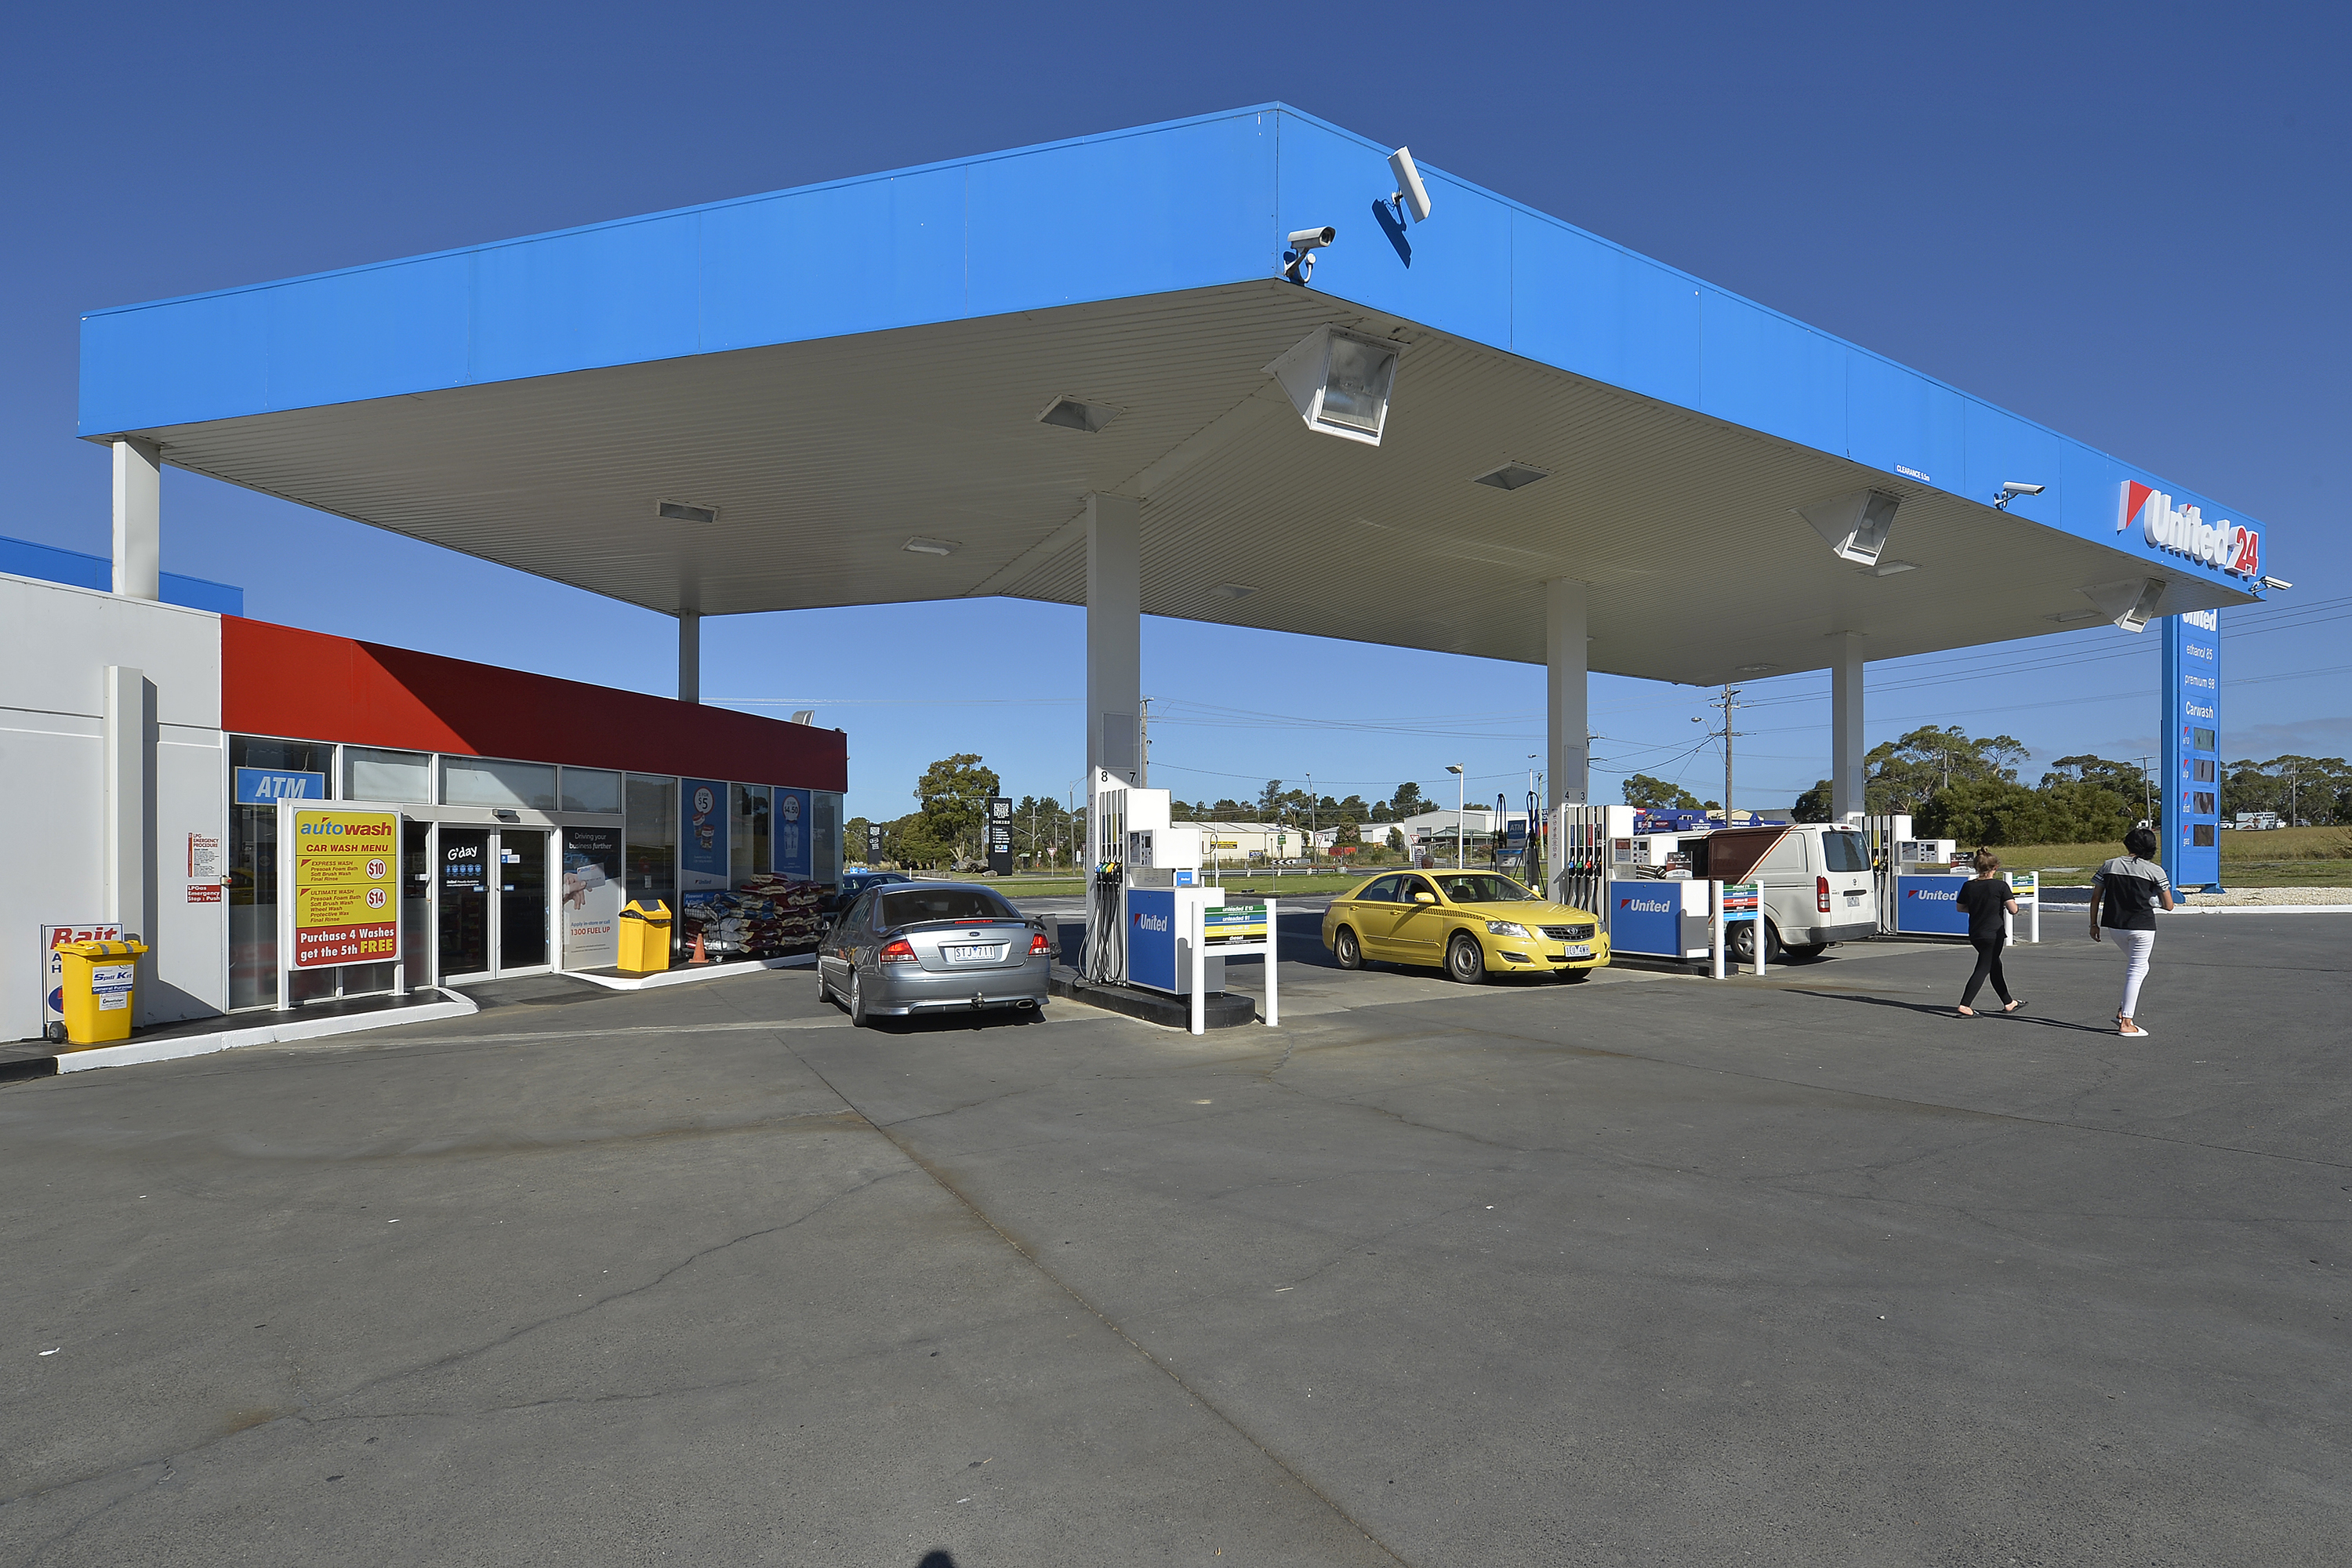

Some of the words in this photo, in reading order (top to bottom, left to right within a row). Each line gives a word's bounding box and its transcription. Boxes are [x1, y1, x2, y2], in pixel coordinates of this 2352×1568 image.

[1896, 464, 1921, 478] CLEARANCE
[2145, 490, 2230, 565] United
[2230, 525, 2259, 577] 24
[2187, 644, 2205, 659] ethanol
[2206, 648, 2213, 660] 85
[2184, 674, 2207, 688] premium
[2209, 678, 2216, 689] 98
[2186, 701, 2214, 719] Carwash
[1101, 771, 1108, 782] 8
[1129, 772, 1136, 782] 7
[255, 776, 307, 799] ATM
[1565, 791, 1570, 800] 4
[698, 797, 708, 809] $5
[1564, 804, 1570, 813] 6
[300, 818, 392, 836] autowash
[1509, 823, 1525, 832] ATM
[448, 846, 477, 861] G'day
[368, 862, 384, 876] $10
[368, 891, 384, 906] $14
[1918, 890, 1958, 901] United
[1631, 899, 1671, 913] United
[1141, 913, 1168, 932] United
[50, 927, 118, 949] Bait
[300, 930, 347, 944] Purchase
[350, 929, 356, 939] 4
[359, 927, 394, 938] Washes
[571, 927, 586, 936] 1300
[300, 949, 318, 962] get
[321, 946, 338, 958] the
[340, 944, 358, 956] 5th
[360, 938, 394, 954] FREE
[956, 947, 972, 957] STJ
[978, 946, 993, 956] 711
